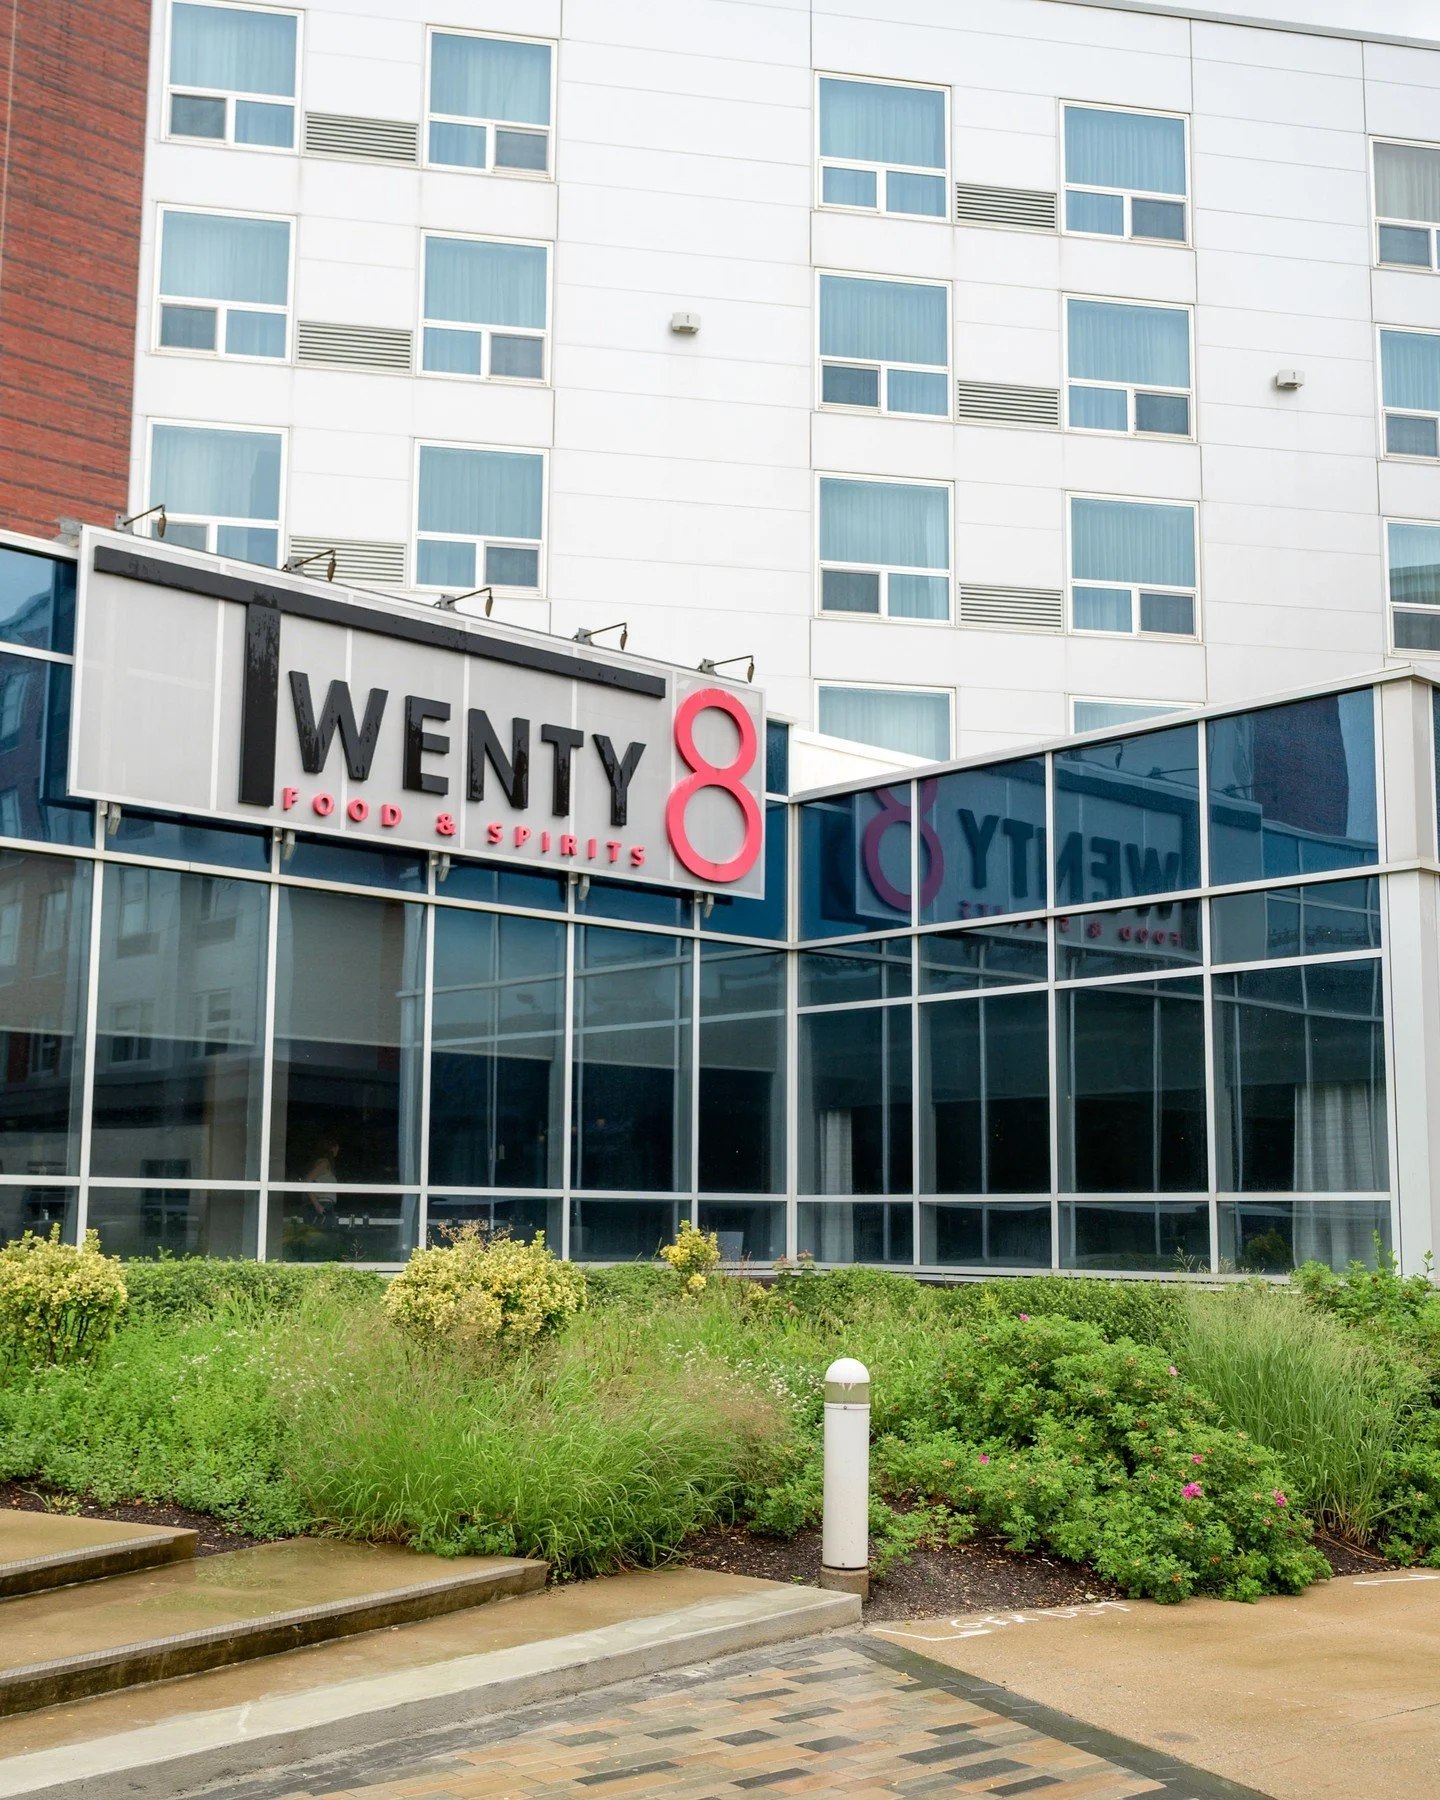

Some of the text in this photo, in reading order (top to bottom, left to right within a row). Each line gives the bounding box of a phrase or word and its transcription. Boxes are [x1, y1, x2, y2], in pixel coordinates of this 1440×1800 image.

[94, 545, 763, 882] TWENTY 8
[282, 786, 646, 868] FOOD & SPIRITS
